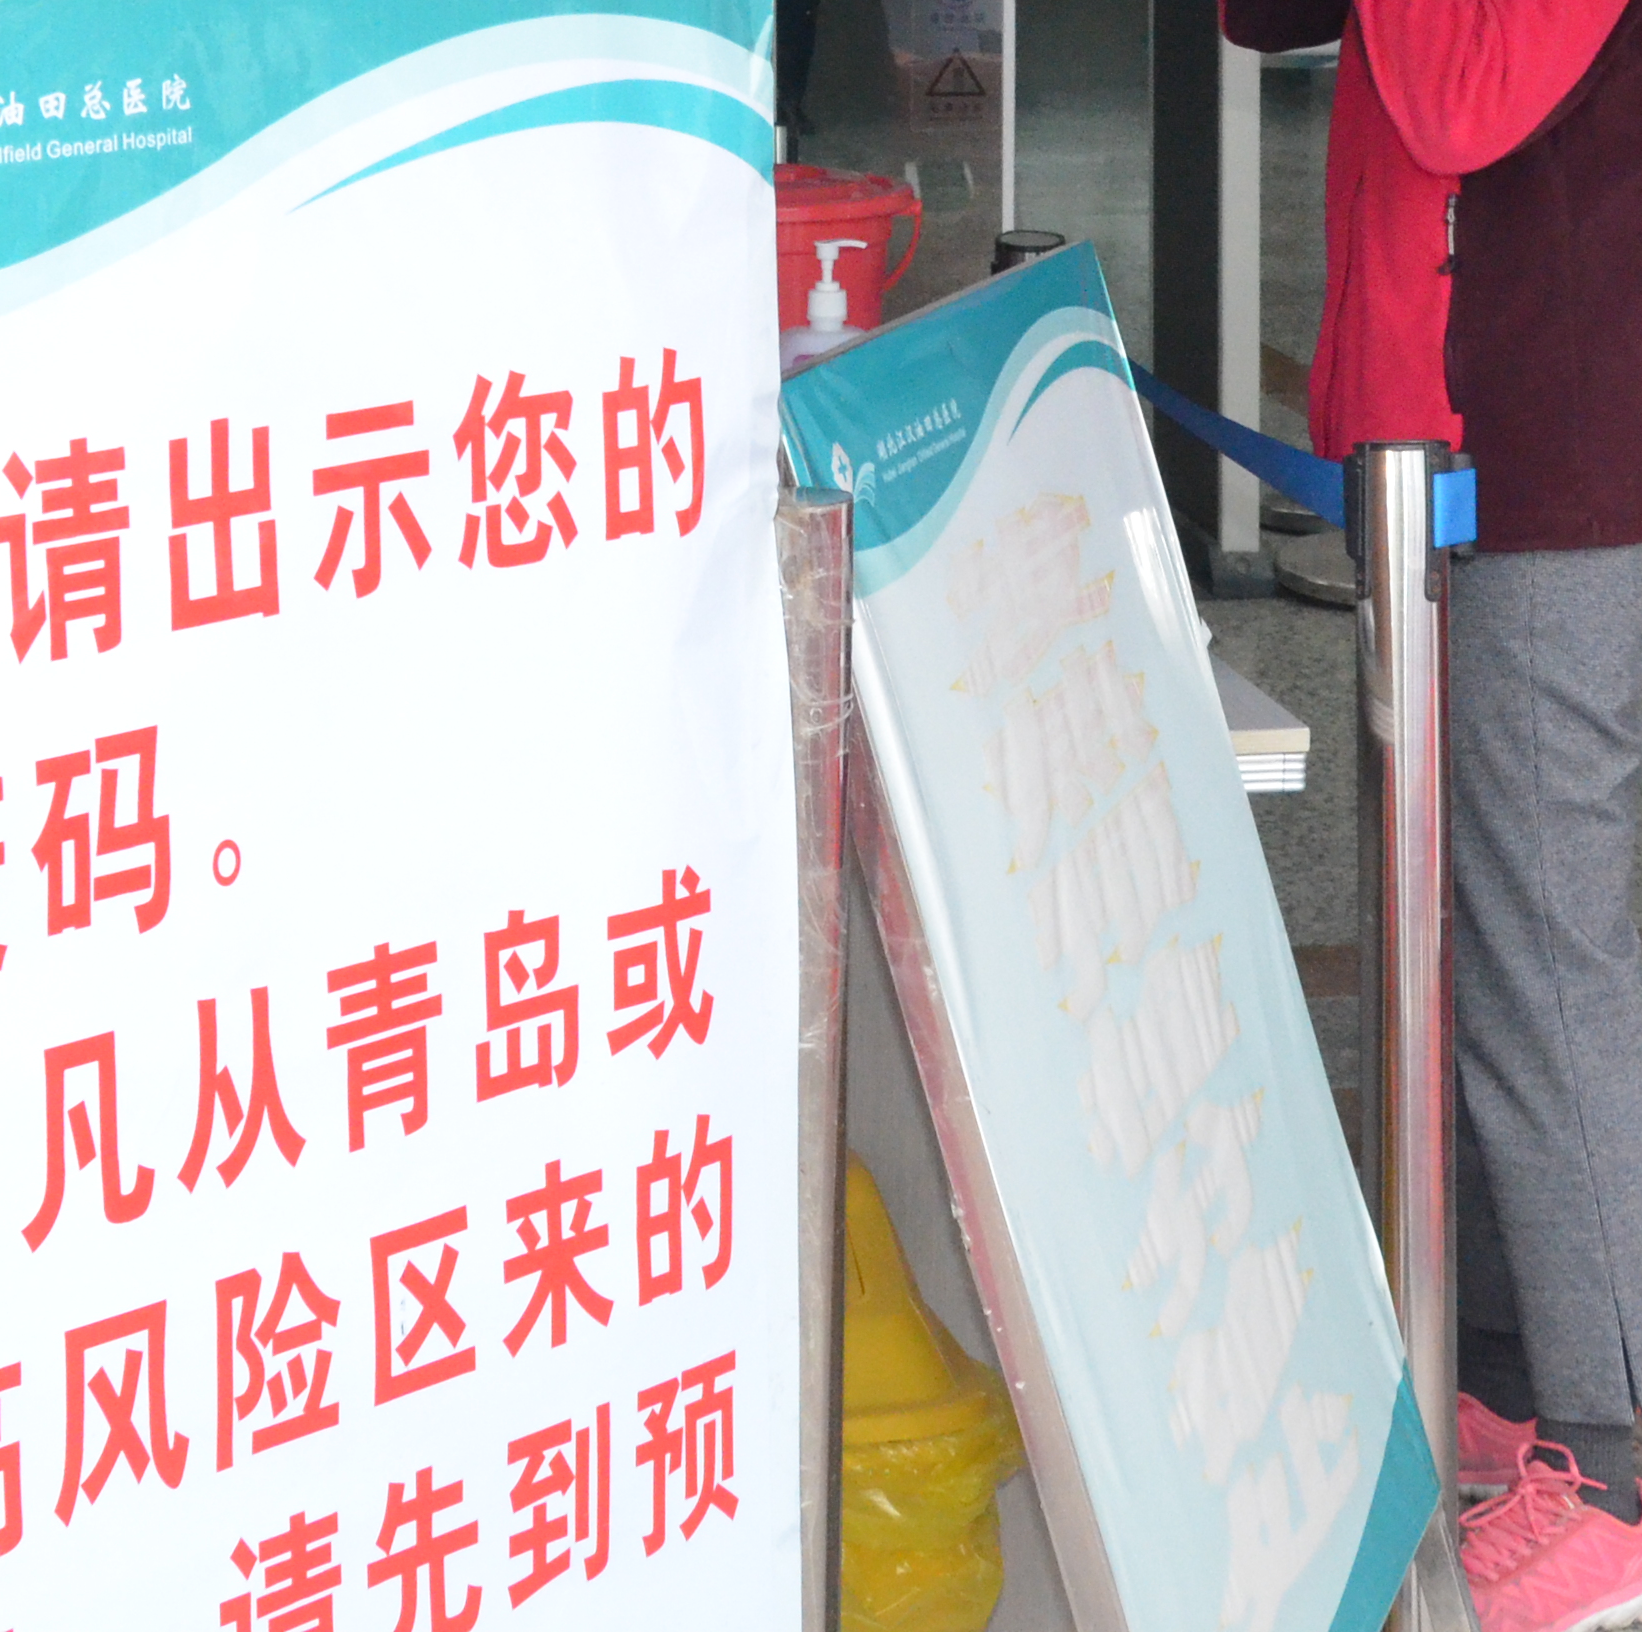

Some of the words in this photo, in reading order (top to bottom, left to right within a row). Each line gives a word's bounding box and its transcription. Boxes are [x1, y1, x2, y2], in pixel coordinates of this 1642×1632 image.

[45, 134, 119, 159] General
[122, 126, 193, 152] Hospital
[21, 864, 715, 1253] 凡从青岛或
[219, 1349, 740, 1632] 请先到预
